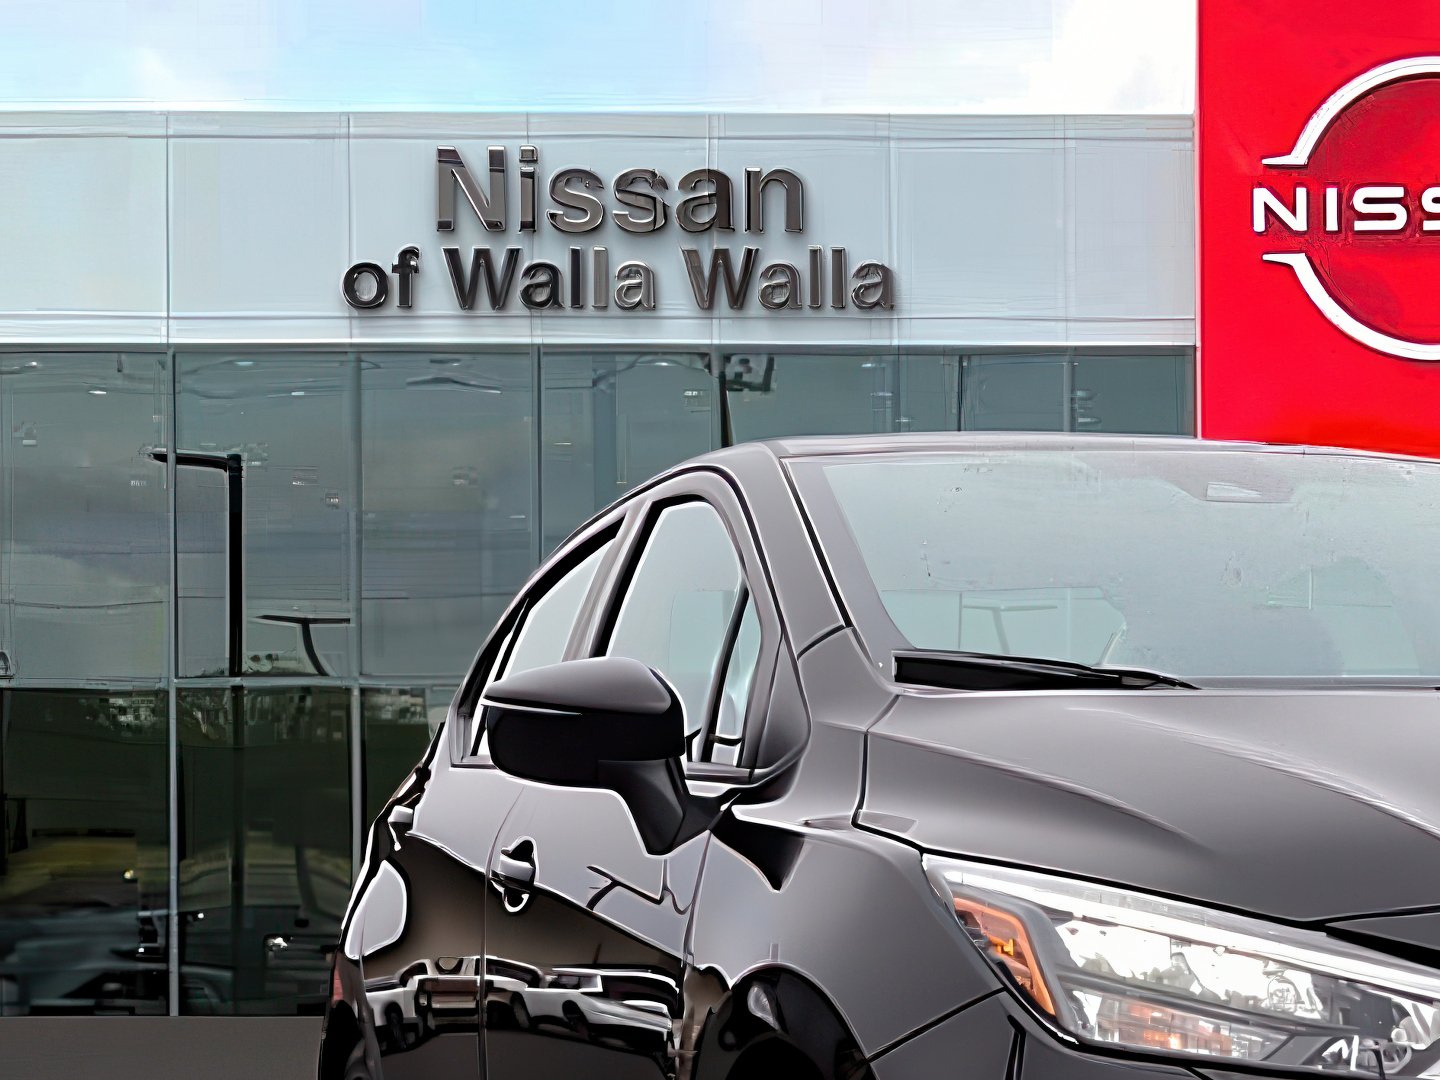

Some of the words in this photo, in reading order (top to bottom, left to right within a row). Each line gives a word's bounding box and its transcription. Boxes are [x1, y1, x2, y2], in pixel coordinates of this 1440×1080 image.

[436, 145, 806, 233] Nissan
[341, 246, 421, 309] of
[442, 245, 656, 310] Walla
[681, 245, 895, 310] Walla
